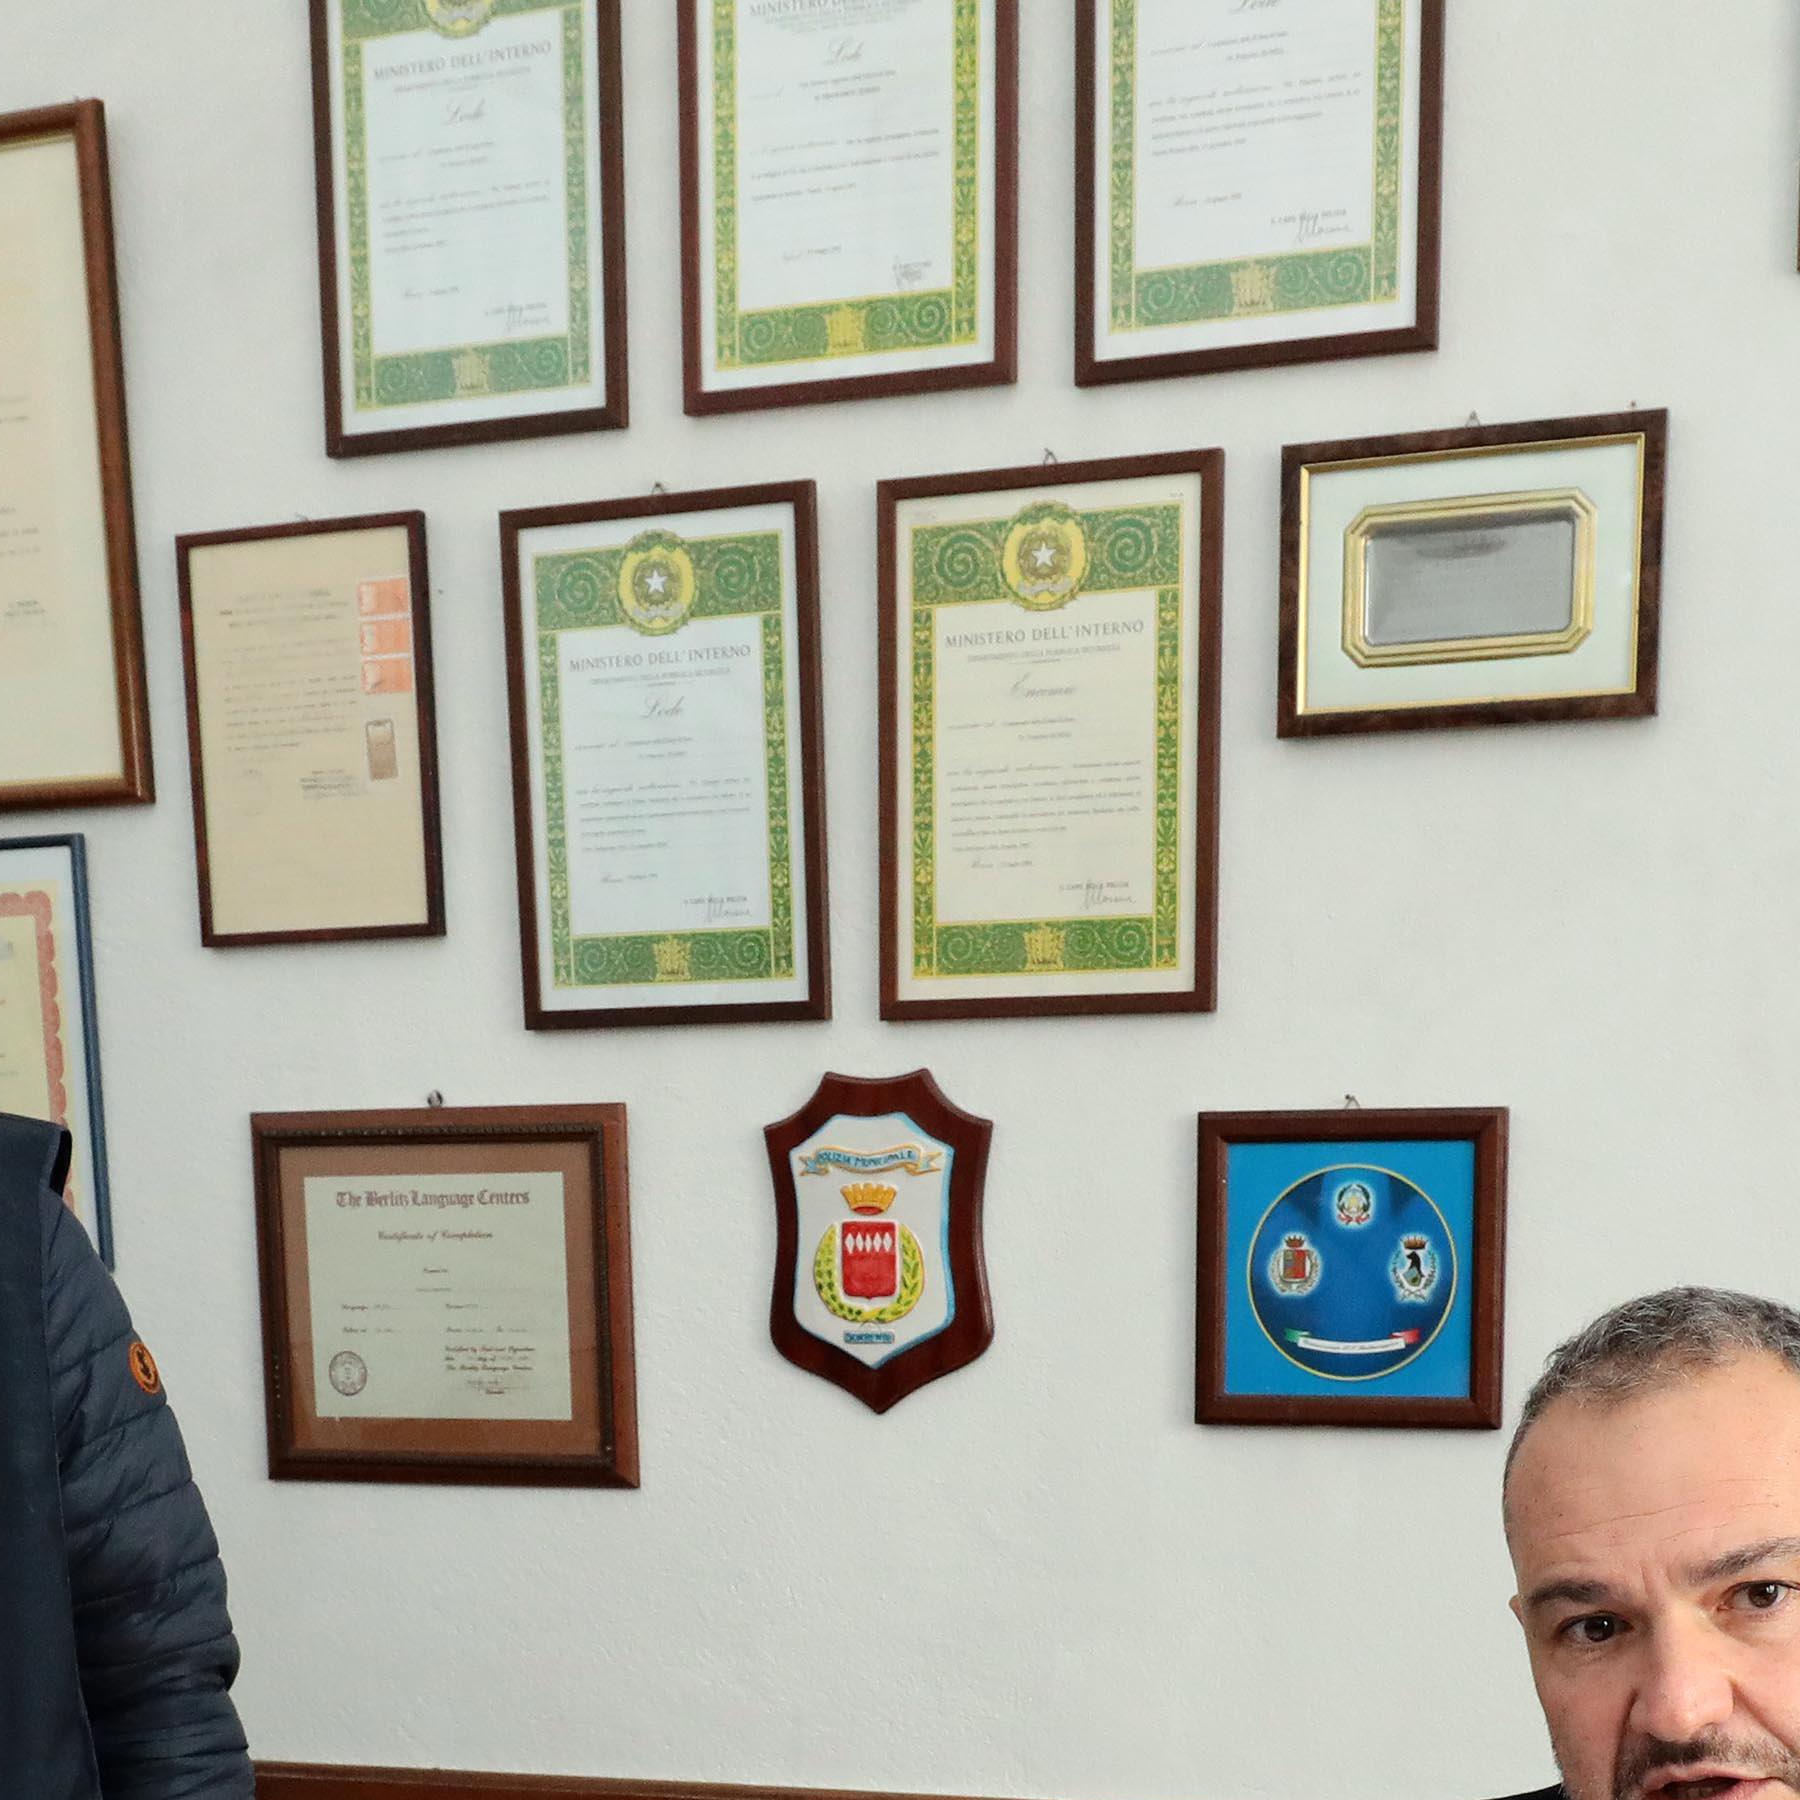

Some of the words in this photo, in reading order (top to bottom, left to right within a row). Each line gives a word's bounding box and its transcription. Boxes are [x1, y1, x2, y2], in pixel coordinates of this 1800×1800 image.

[373, 56, 447, 80] MINISTERO
[945, 629, 1026, 648] MINISTERO
[569, 653, 643, 673] MINISTERO
[336, 1191, 362, 1208] The
[410, 1189, 475, 1209] Language
[477, 1188, 531, 1206] Centers
